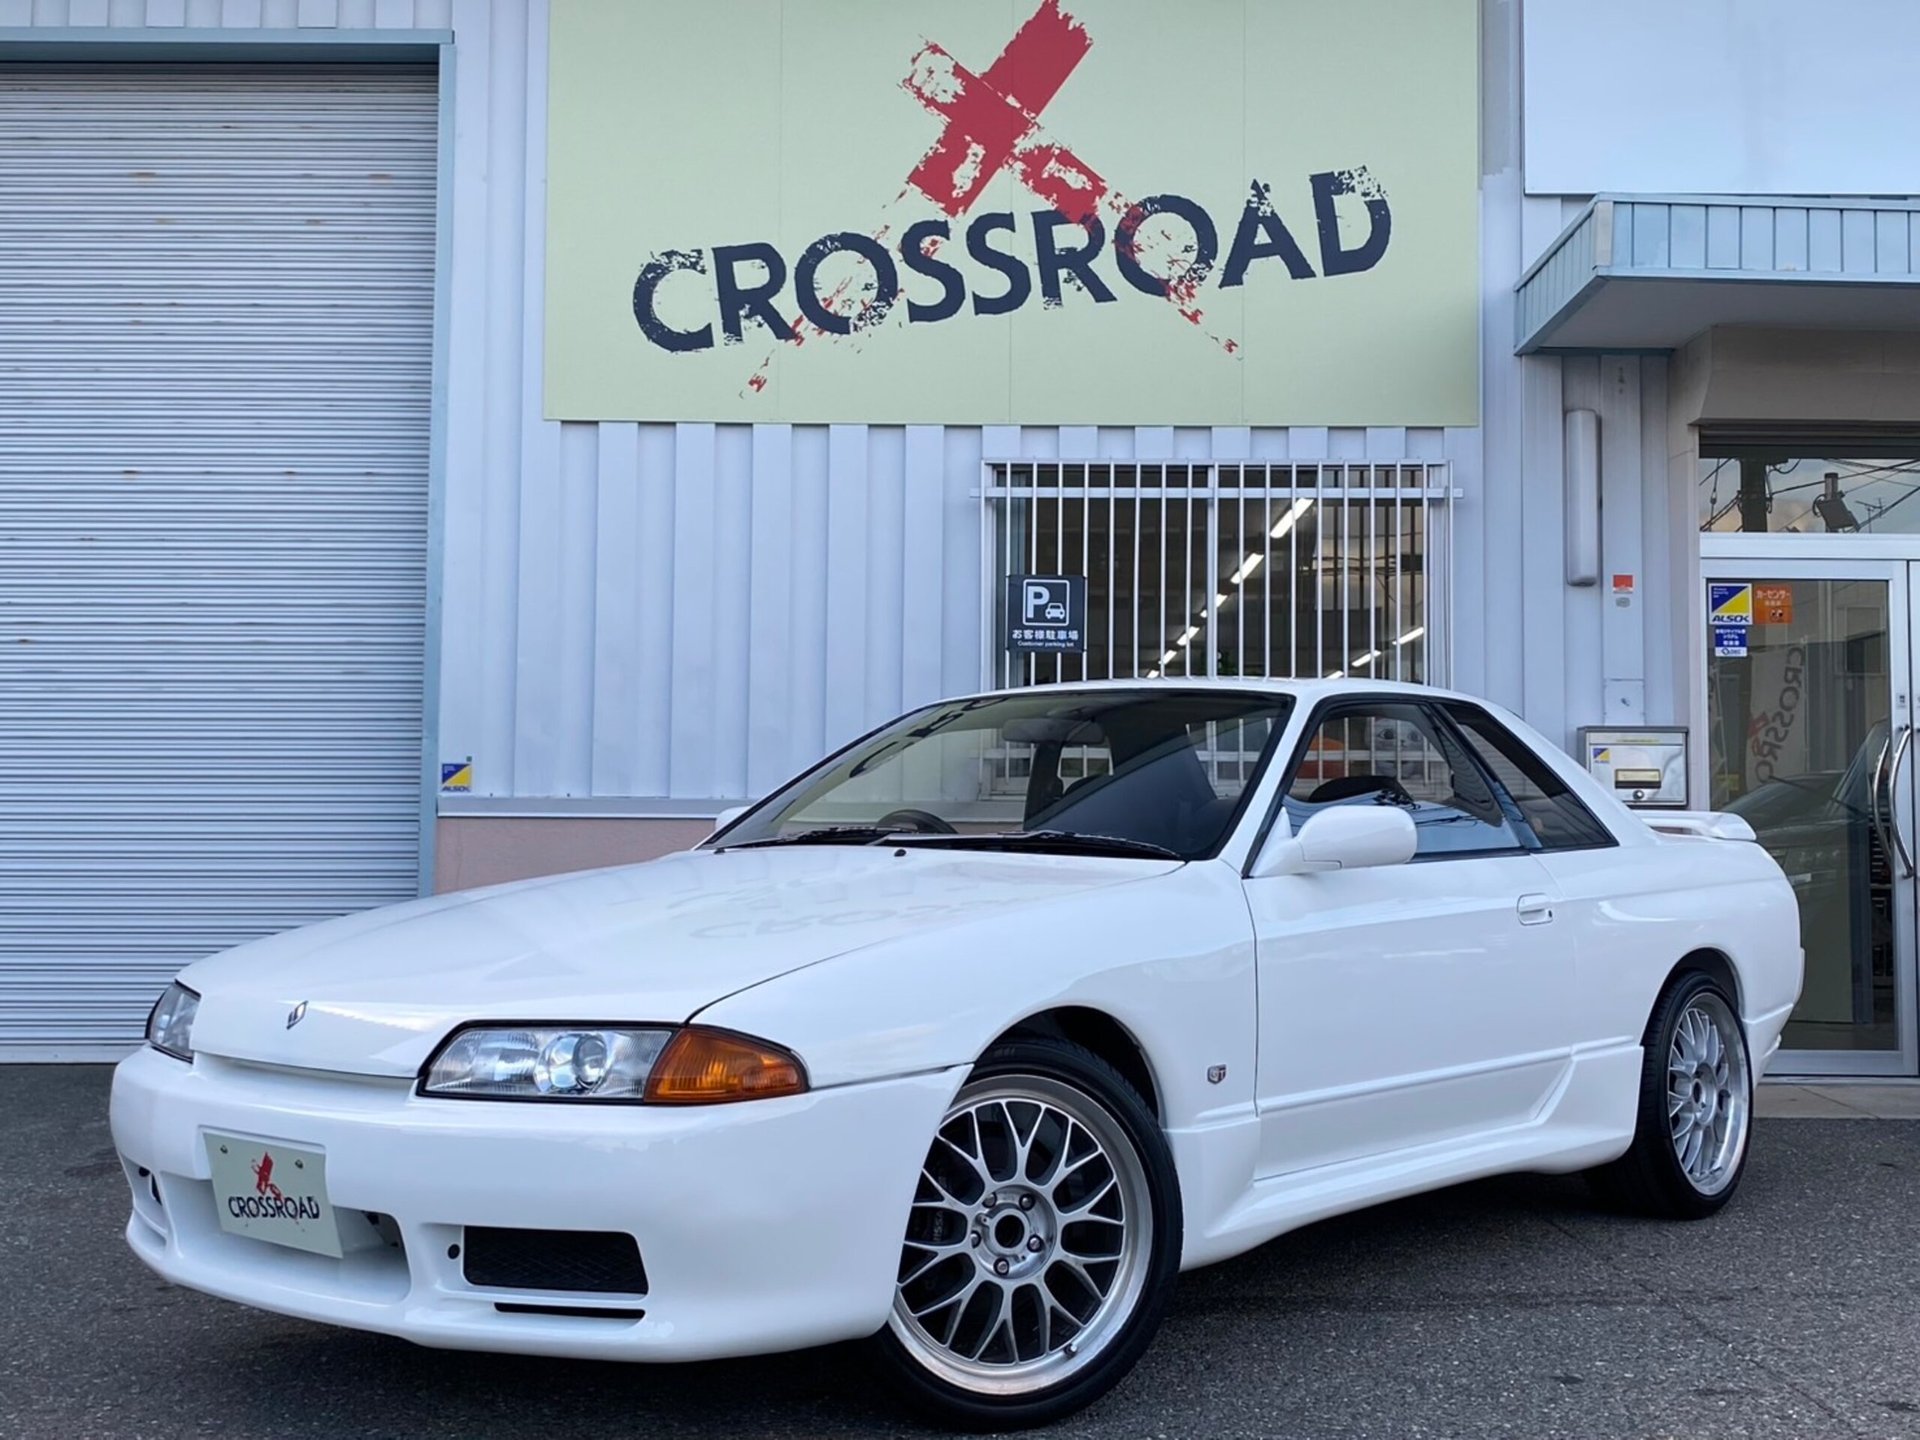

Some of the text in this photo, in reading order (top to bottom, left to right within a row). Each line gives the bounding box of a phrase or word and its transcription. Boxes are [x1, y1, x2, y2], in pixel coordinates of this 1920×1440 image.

[633, 165, 1392, 354] CROSSROAD
[1026, 585, 1050, 618] P
[1712, 614, 1750, 623] ALSOK
[1012, 629, 1078, 640] お客様駐車場
[228, 1195, 320, 1220] CROSSROAD
